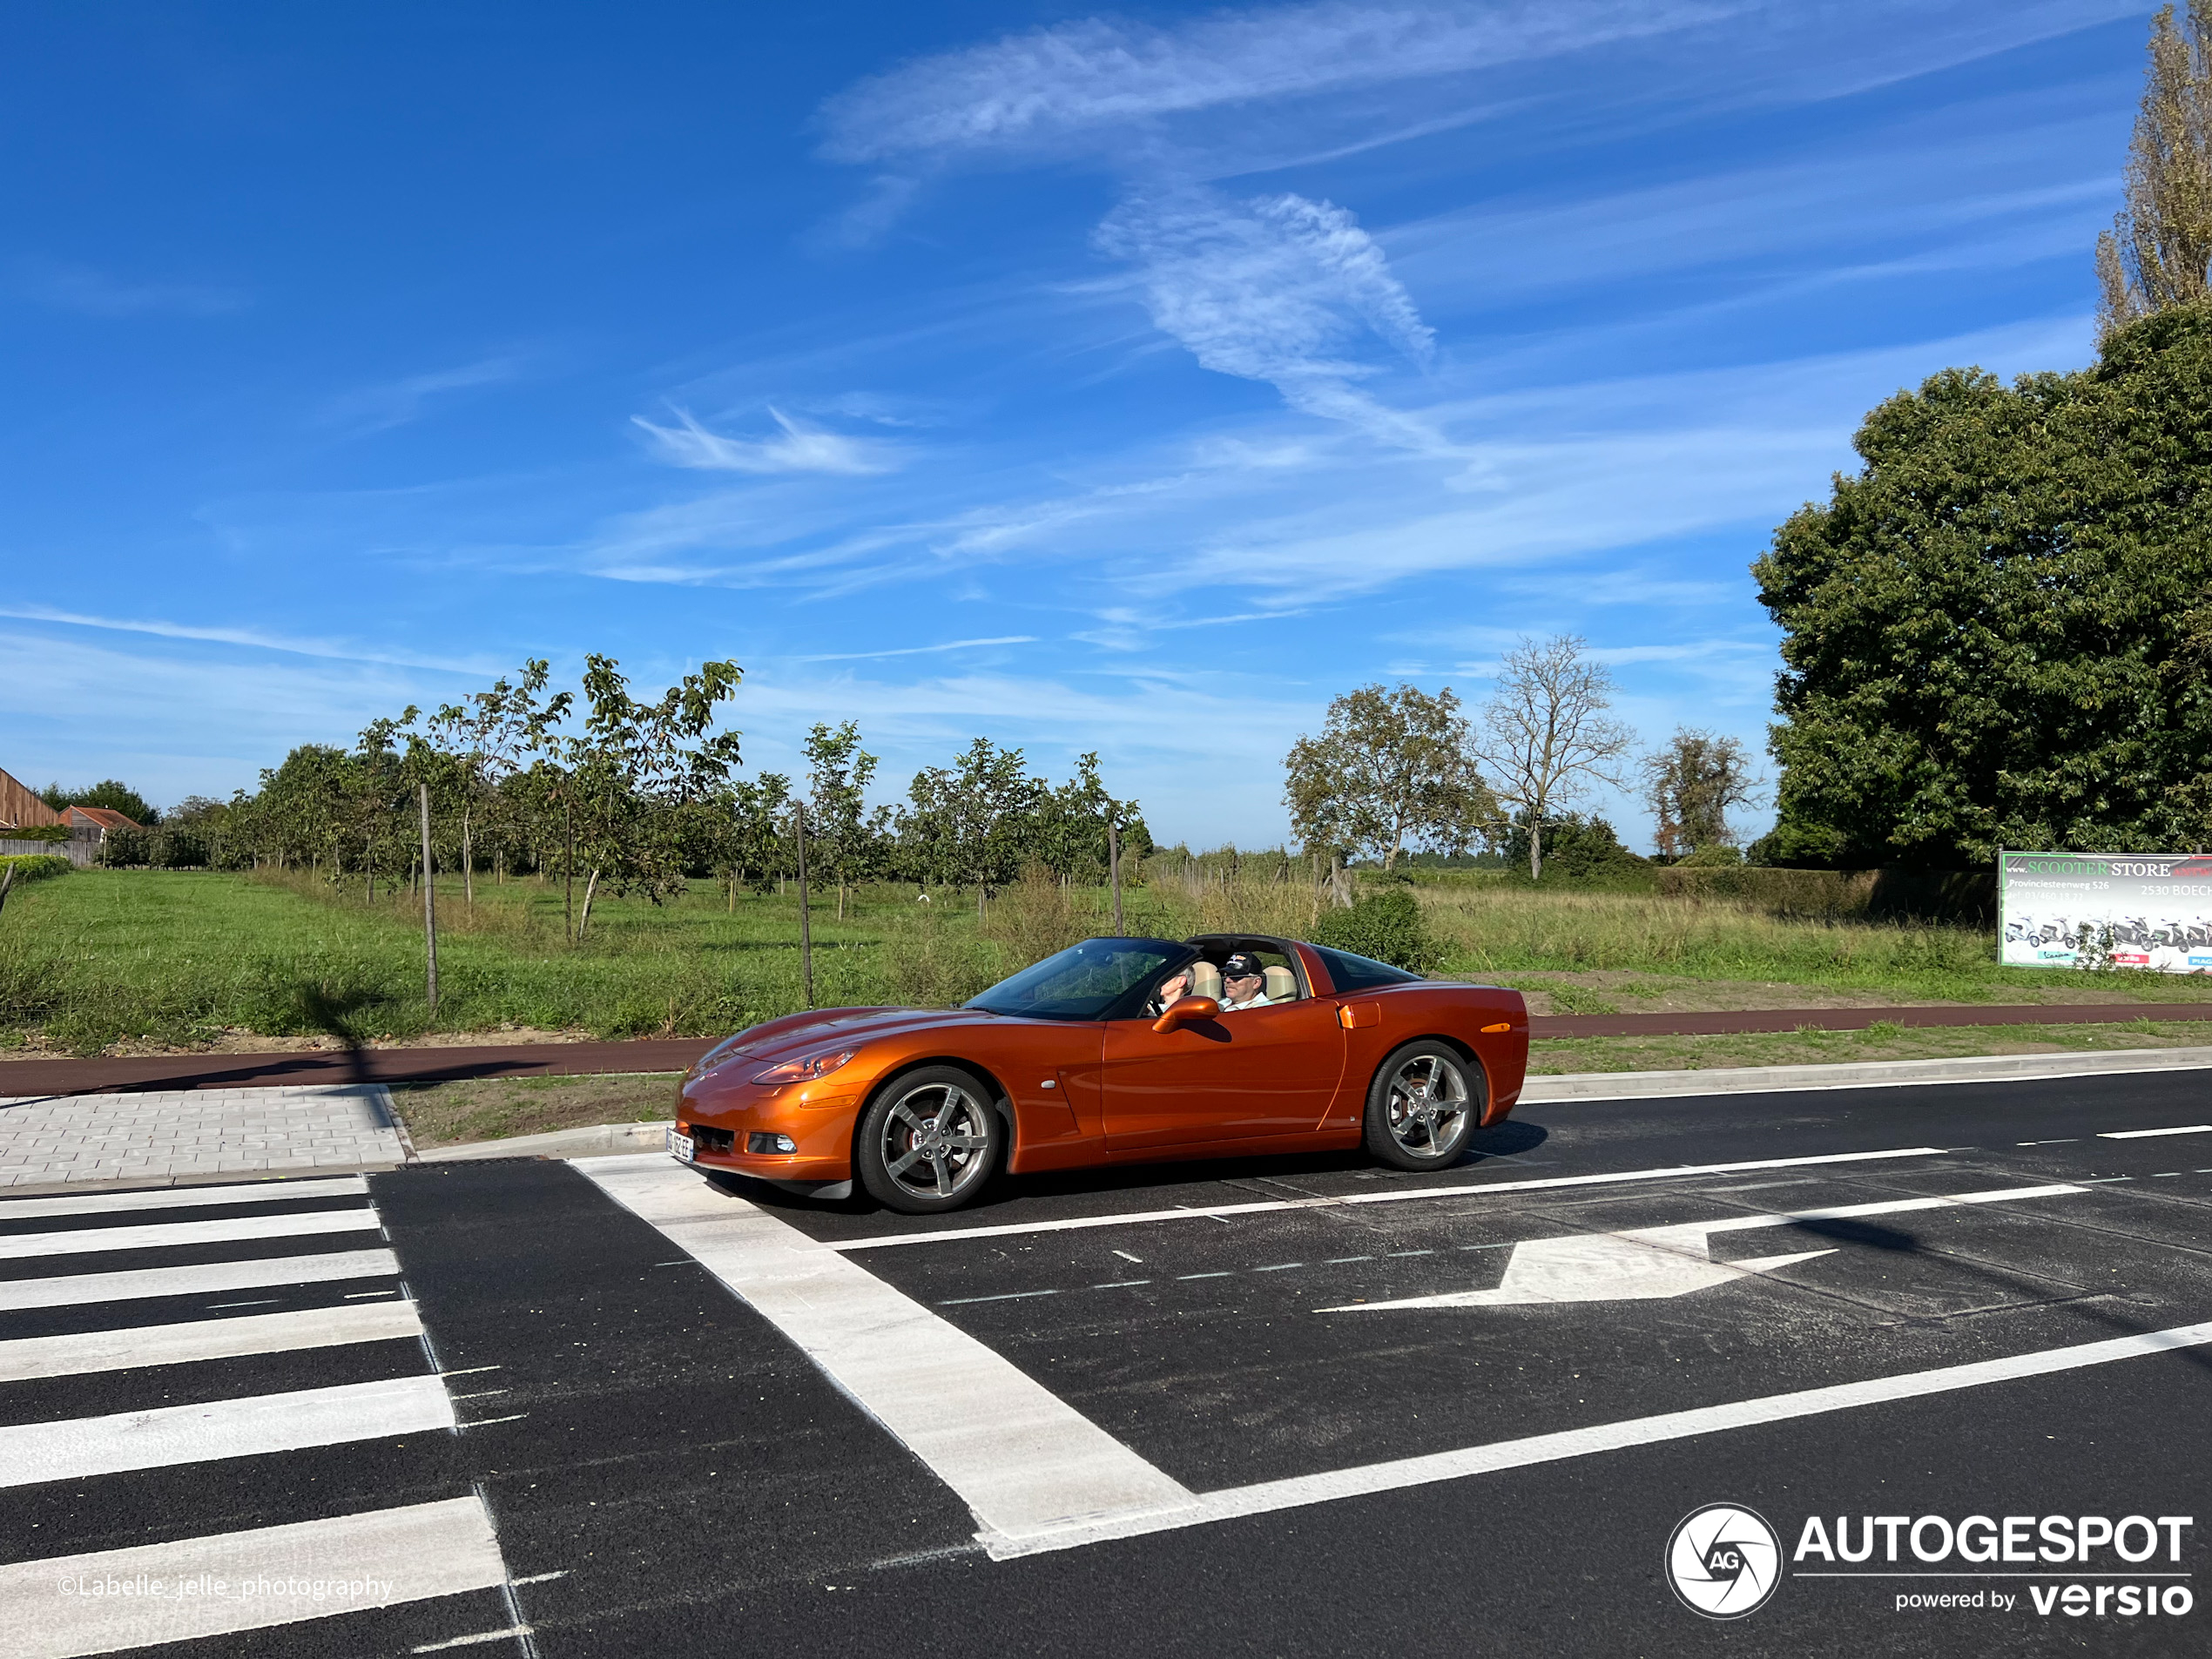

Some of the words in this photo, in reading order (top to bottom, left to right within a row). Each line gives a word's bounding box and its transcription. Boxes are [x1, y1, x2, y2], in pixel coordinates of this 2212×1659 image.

[2111, 862, 2171, 877] STORE
[2008, 879, 2091, 891] Provinciesteenweg
[2092, 881, 2110, 890] 526
[2141, 885, 2169, 896] 2530
[2025, 891, 2057, 900] 03/460
